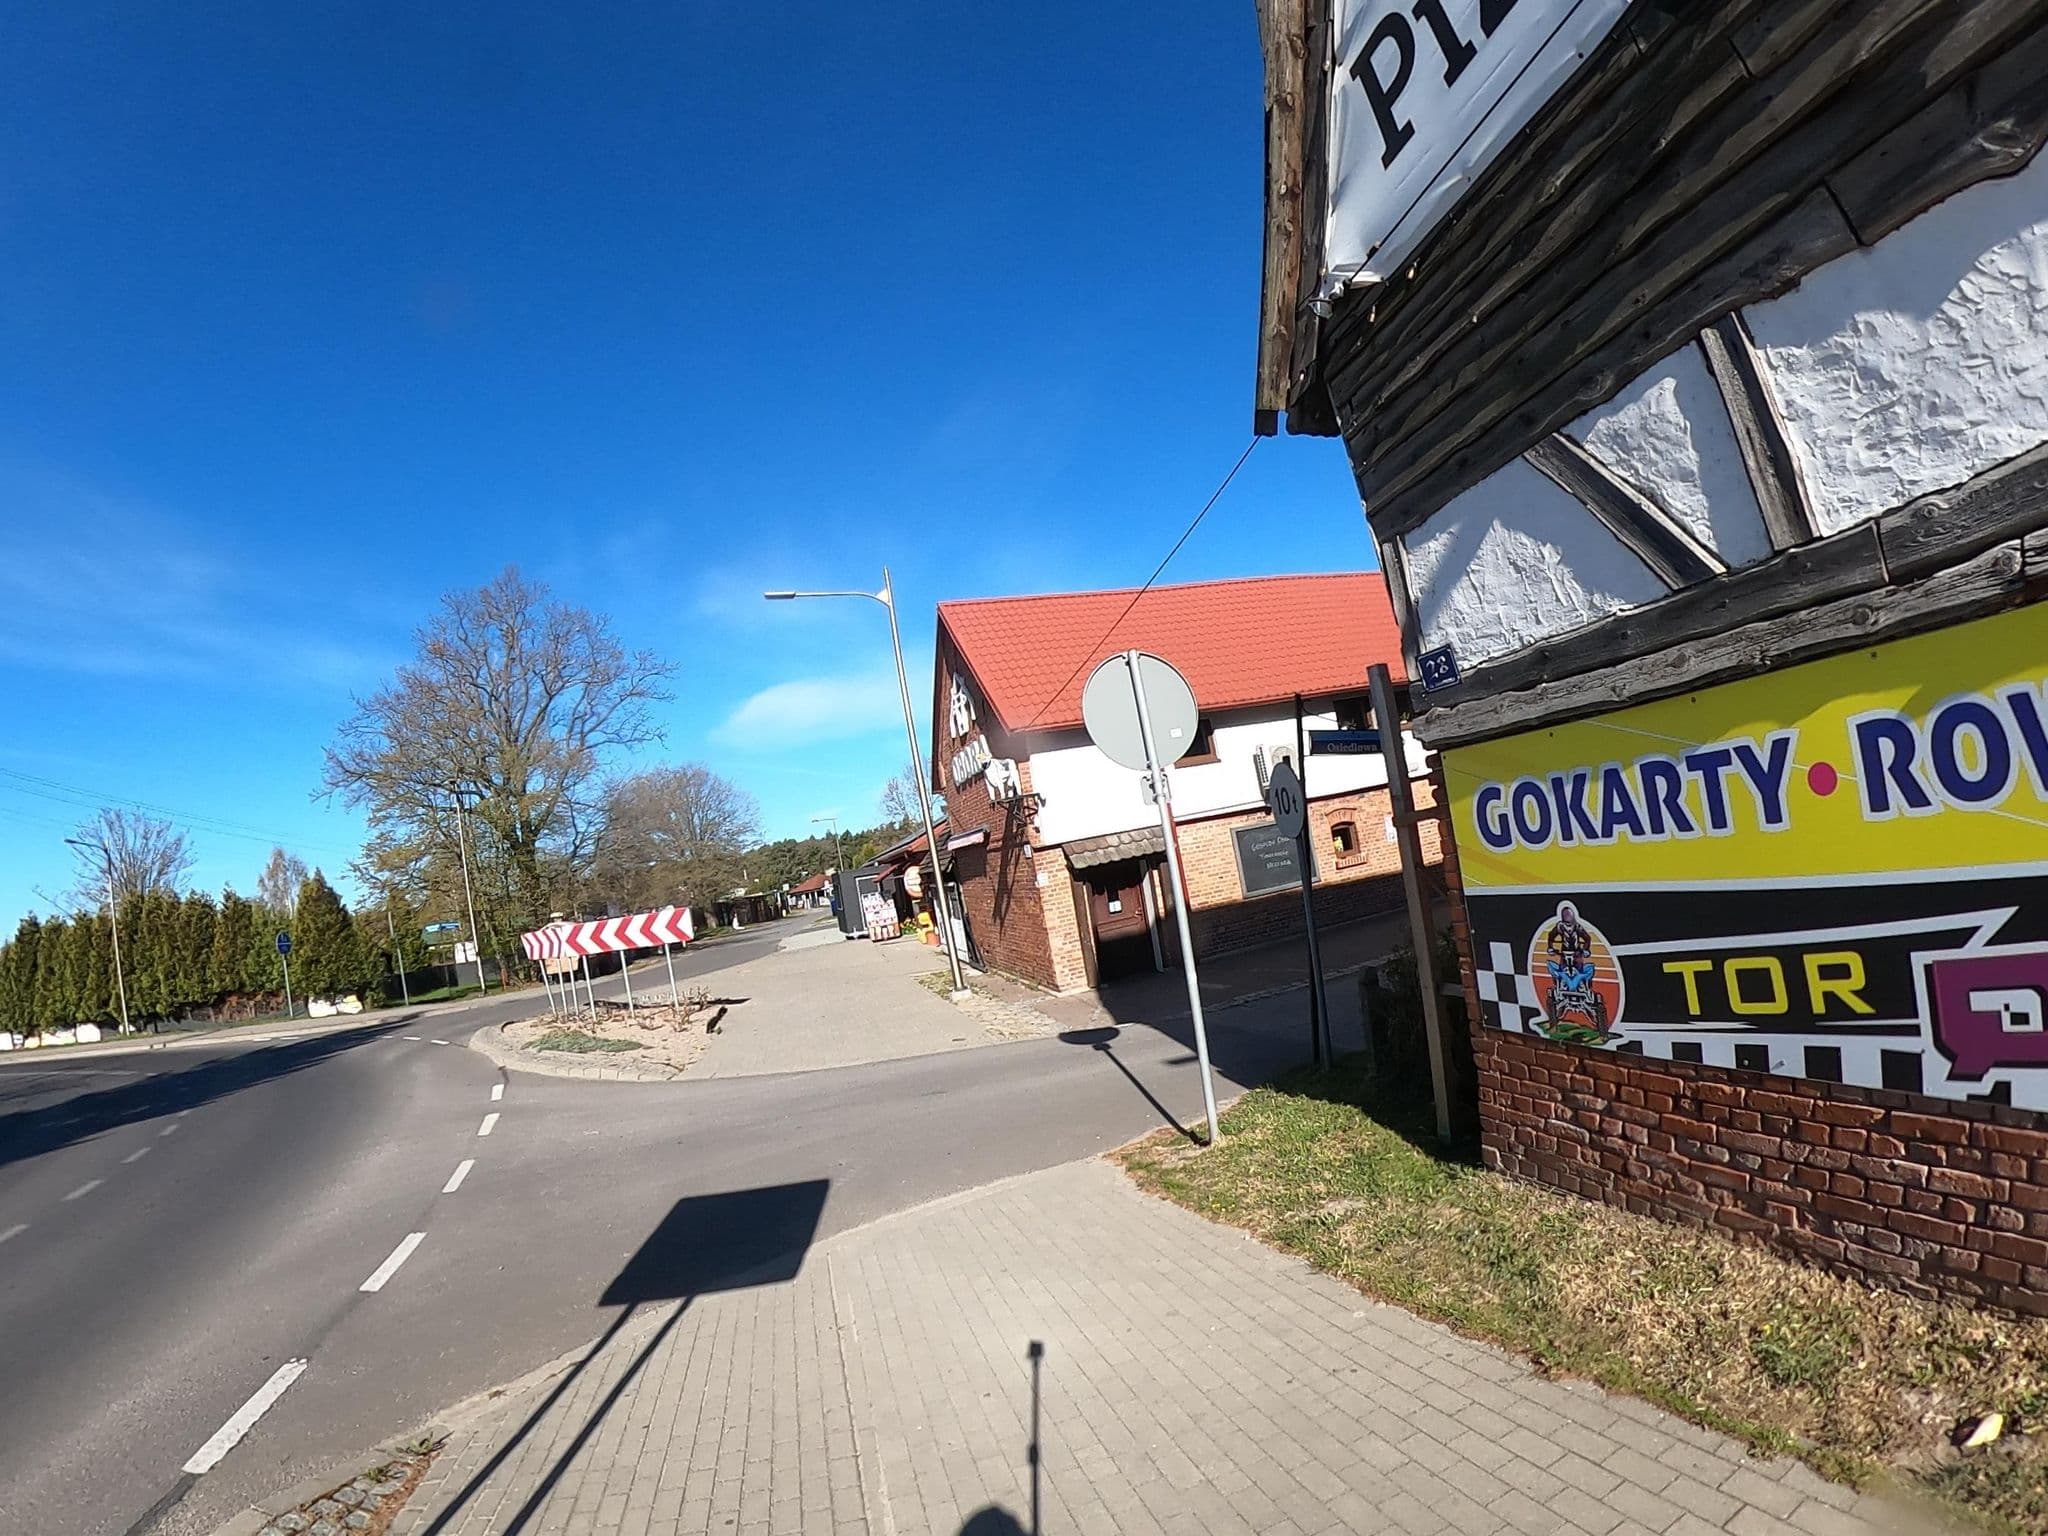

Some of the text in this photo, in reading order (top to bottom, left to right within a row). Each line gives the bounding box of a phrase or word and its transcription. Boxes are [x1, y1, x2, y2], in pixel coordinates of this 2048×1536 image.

[1425, 655, 1450, 679] 28
[1327, 742, 1378, 753] Osiedlowa
[1473, 732, 1792, 850] GOKARTY
[1663, 951, 1877, 1015] TOR
